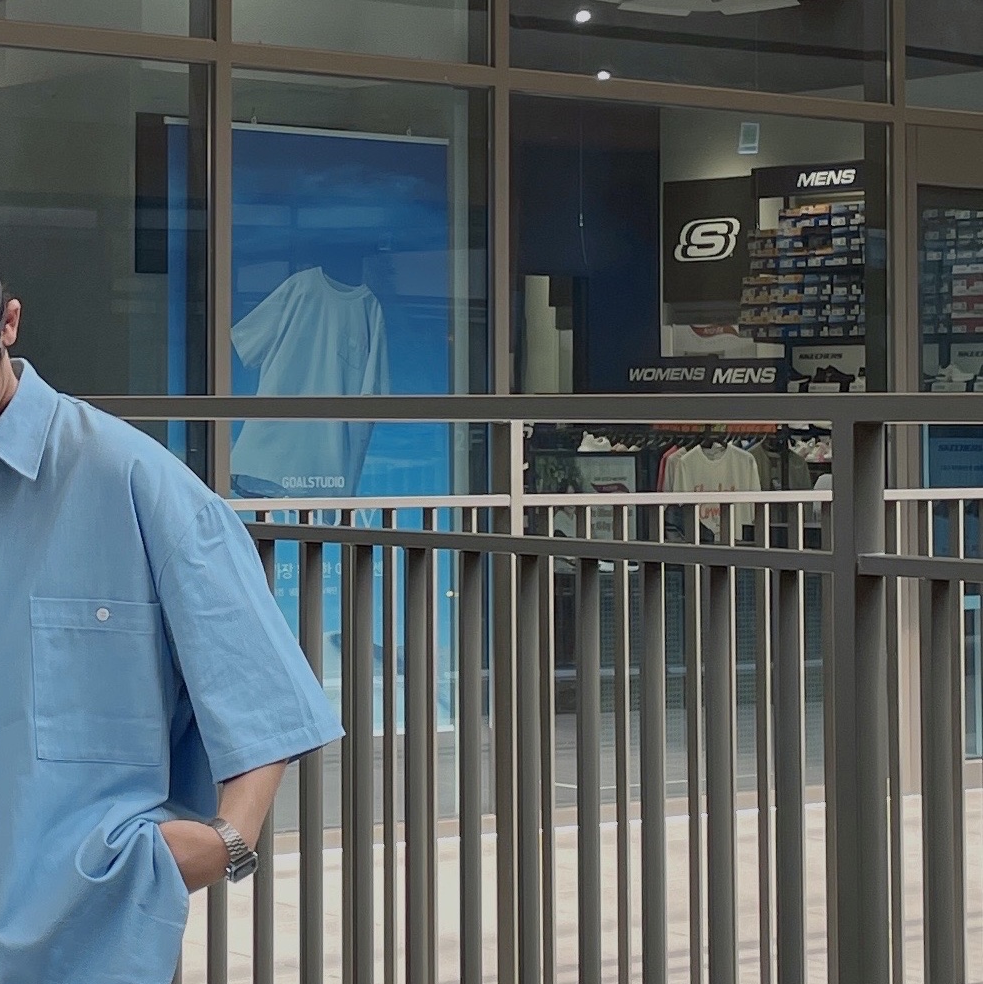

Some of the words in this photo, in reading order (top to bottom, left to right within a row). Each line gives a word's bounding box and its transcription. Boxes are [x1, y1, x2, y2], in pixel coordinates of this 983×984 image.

[796, 169, 856, 187] MENS
[629, 368, 706, 381] WOMENS
[712, 368, 777, 384] MENS
[281, 476, 345, 489] GOALSTUDIO
